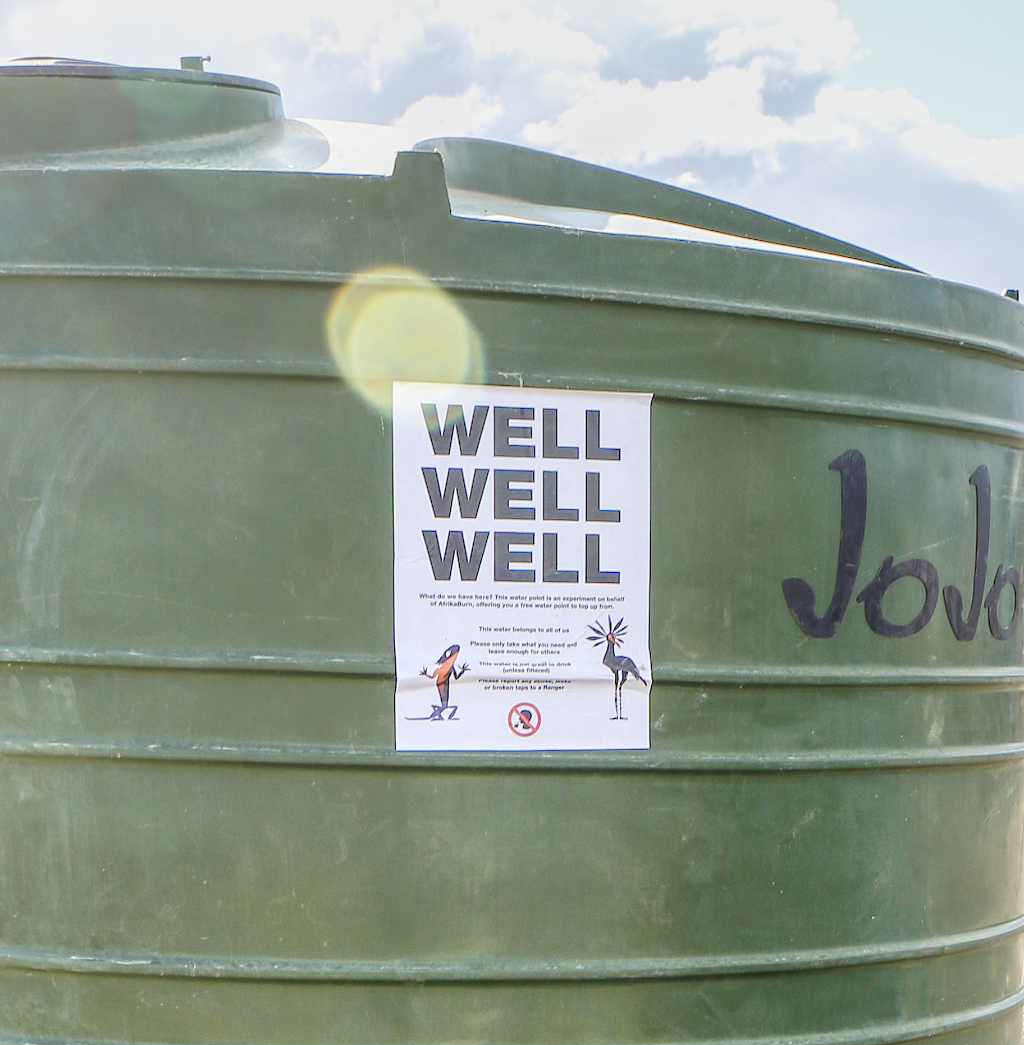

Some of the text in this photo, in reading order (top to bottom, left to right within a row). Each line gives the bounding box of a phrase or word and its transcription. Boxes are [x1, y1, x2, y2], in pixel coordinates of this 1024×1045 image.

[420, 402, 621, 461] WELL
[421, 466, 621, 523] WELL
[421, 530, 621, 584] WELL
[781, 449, 1021, 641] JoJo
